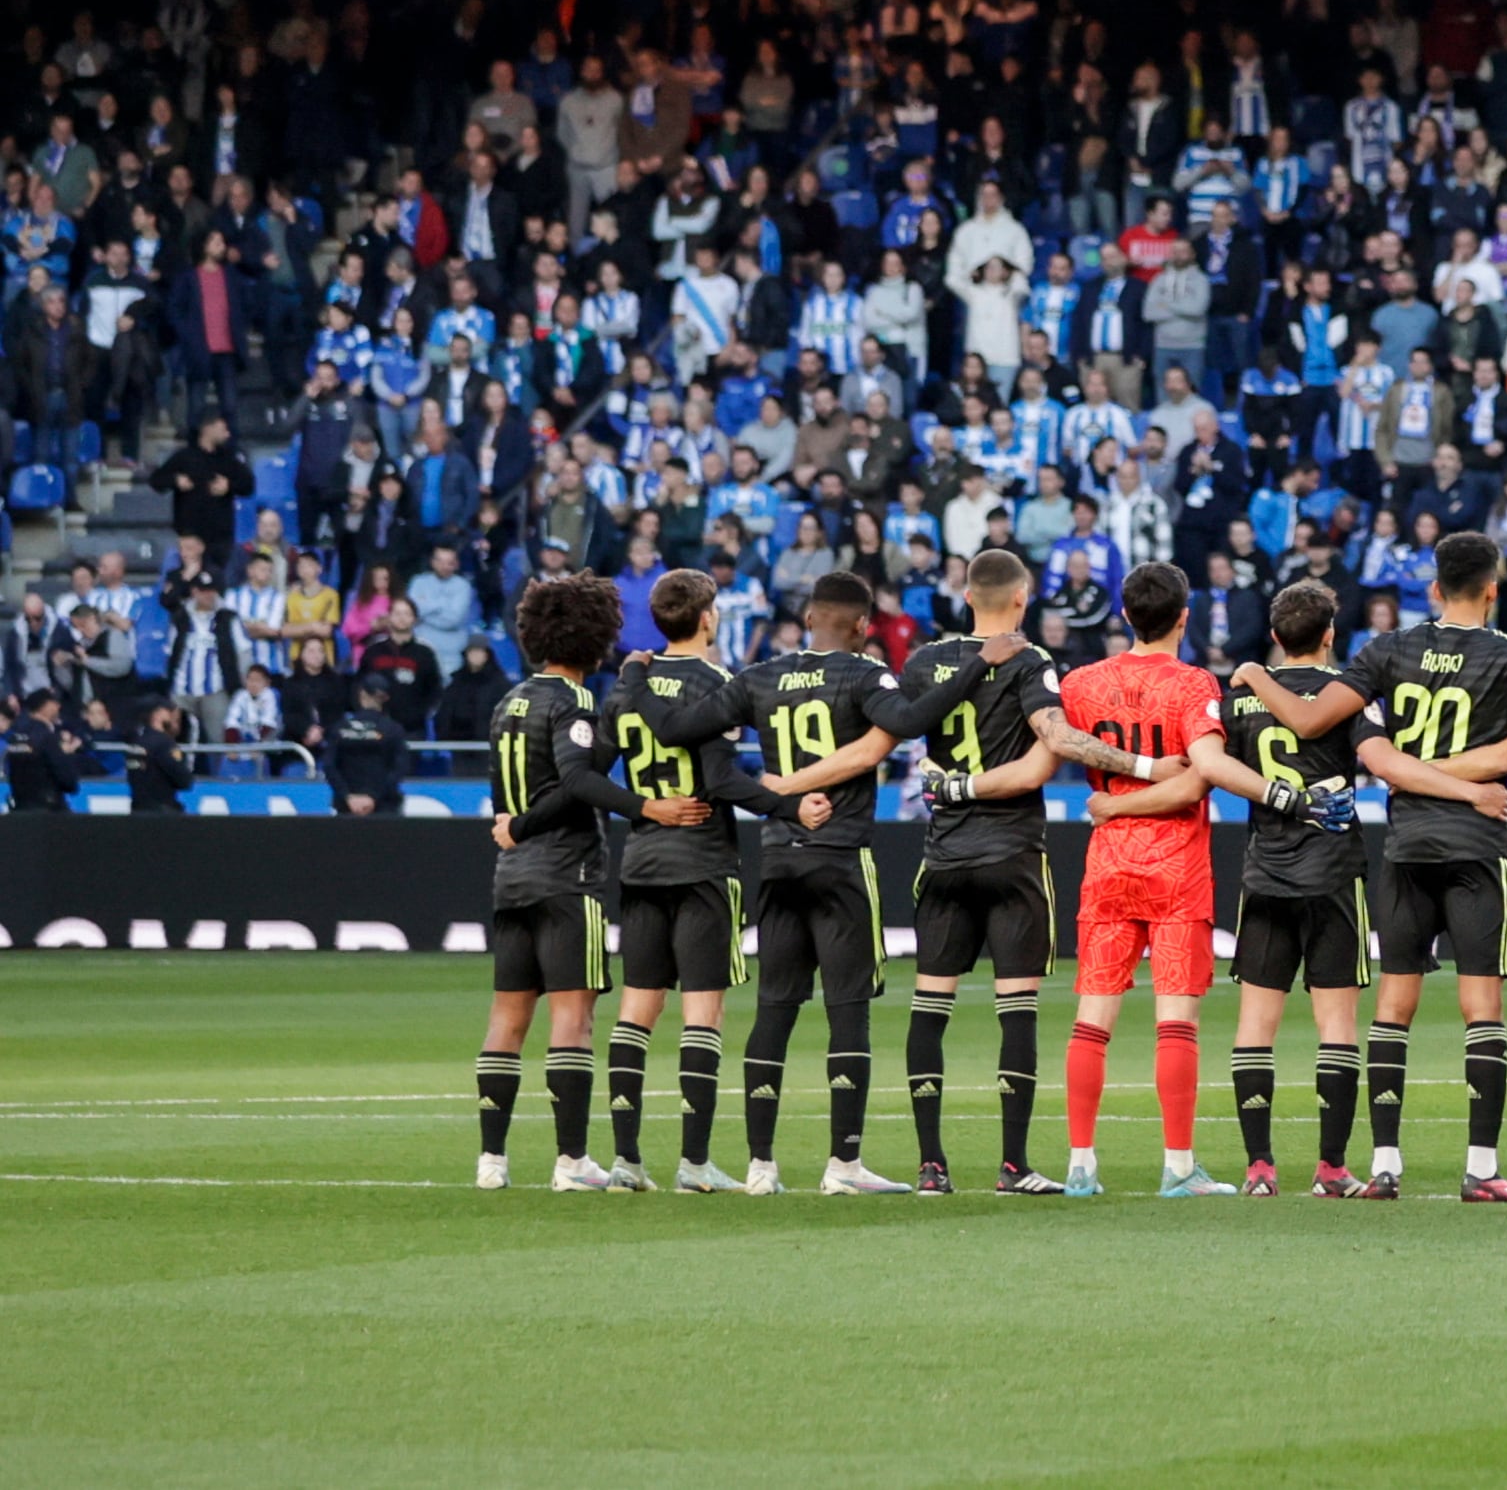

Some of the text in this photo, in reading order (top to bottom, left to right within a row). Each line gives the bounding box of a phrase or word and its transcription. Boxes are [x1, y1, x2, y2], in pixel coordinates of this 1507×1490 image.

[617, 713, 695, 800] 25
[769, 699, 842, 778] 19
[942, 700, 985, 777] 3
[1258, 726, 1307, 793] 6
[1394, 682, 1472, 764] 20
[498, 732, 529, 816] 11
